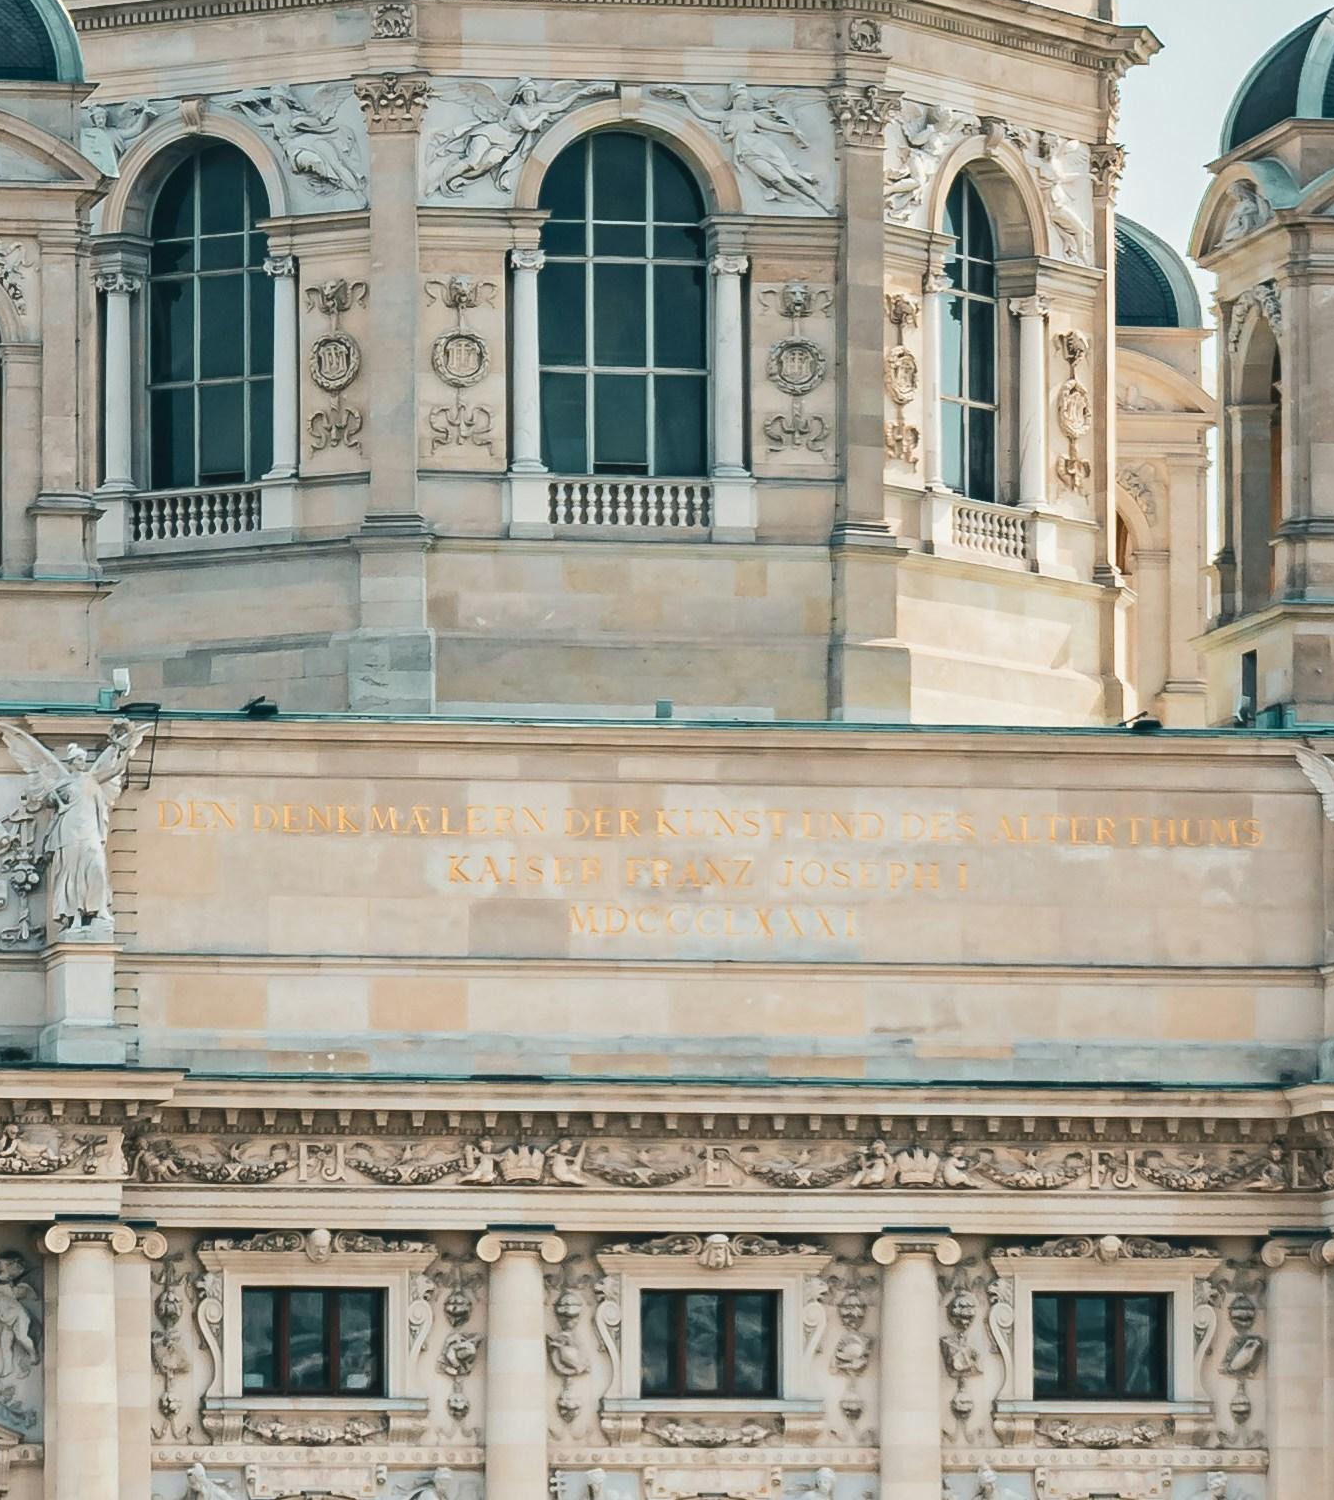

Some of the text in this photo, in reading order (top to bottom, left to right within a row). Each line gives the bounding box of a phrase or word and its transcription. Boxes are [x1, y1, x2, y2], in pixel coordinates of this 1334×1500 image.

[156, 801, 236, 832] DEN
[563, 808, 642, 838] DER
[654, 808, 786, 841] KUNST
[801, 810, 886, 841] UND
[899, 812, 976, 843] DES
[990, 813, 1266, 848] ALTERTHUMS
[447, 855, 603, 887] KAISER
[624, 857, 756, 888] FRANZ
[777, 859, 940, 891] JOSEPH
